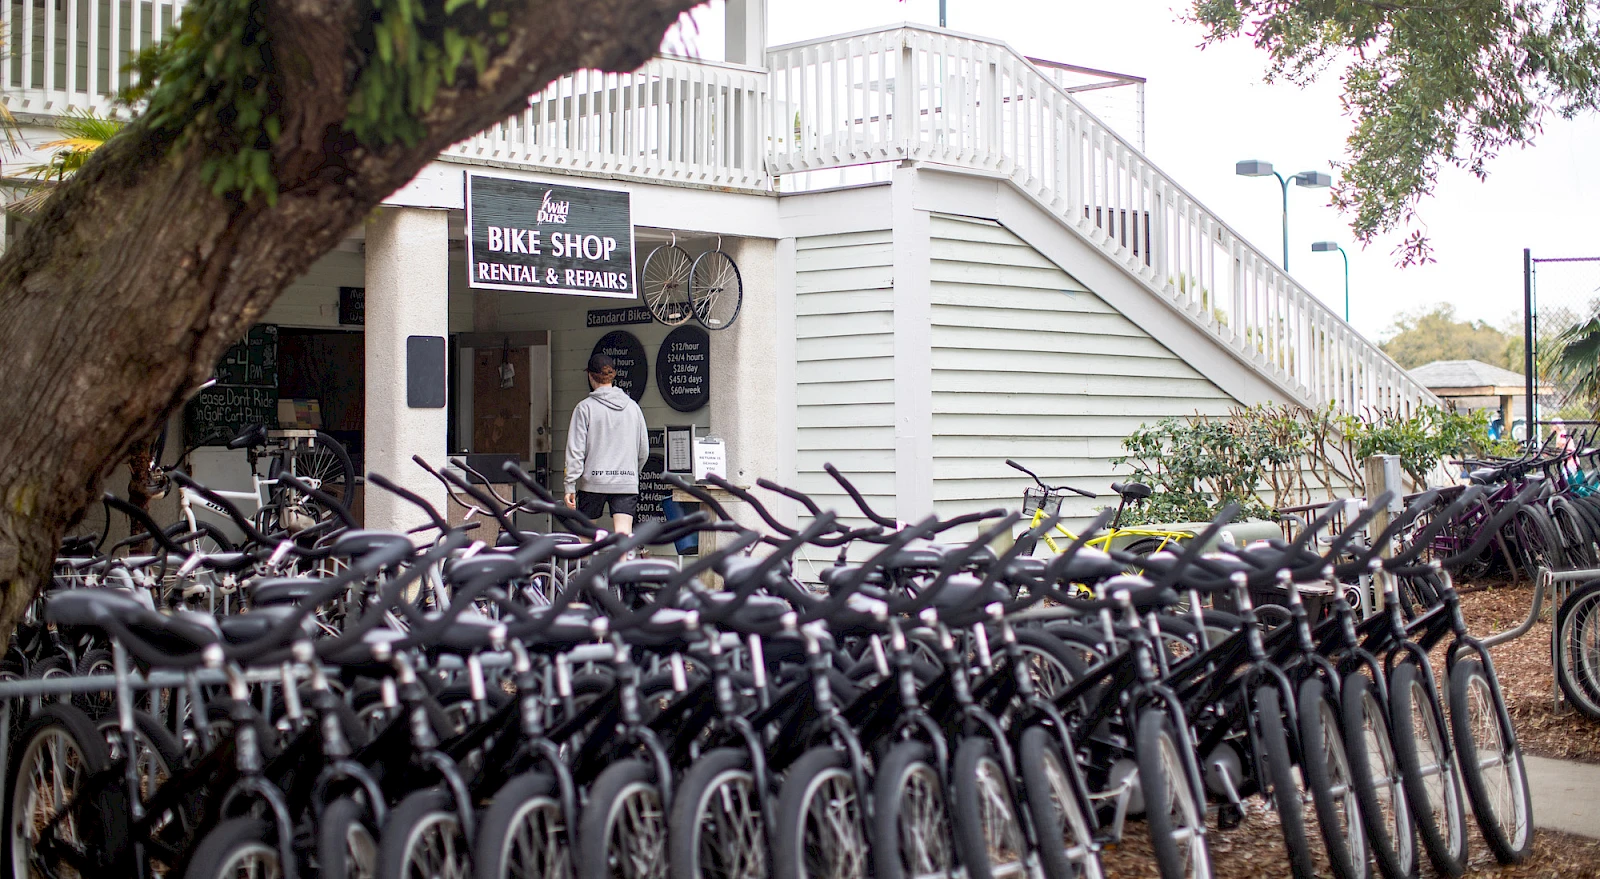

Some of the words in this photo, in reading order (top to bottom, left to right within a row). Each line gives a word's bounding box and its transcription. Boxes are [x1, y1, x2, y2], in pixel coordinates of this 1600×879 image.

[547, 201, 570, 215] Wild
[536, 210, 568, 225] Dunes
[488, 226, 541, 255] BIKE
[551, 232, 616, 261] SHOP
[478, 262, 540, 284] RENTAL
[545, 267, 559, 285] &
[565, 269, 628, 290] REPAIRS
[587, 311, 626, 325] Standard
[627, 308, 651, 321] Bikes
[671, 342, 699, 352] $12/hour
[617, 358, 635, 366] hours
[667, 353, 685, 363] $24/4
[686, 353, 704, 361] hours
[673, 364, 698, 374] $28/day
[618, 379, 633, 388] days
[669, 375, 687, 385] $45/3
[688, 374, 703, 385] days
[670, 386, 701, 396] $60/week
[200, 389, 226, 406] lease
[253, 388, 275, 408] Ride
[203, 404, 224, 422] Golf
[245, 407, 270, 424] Paths
